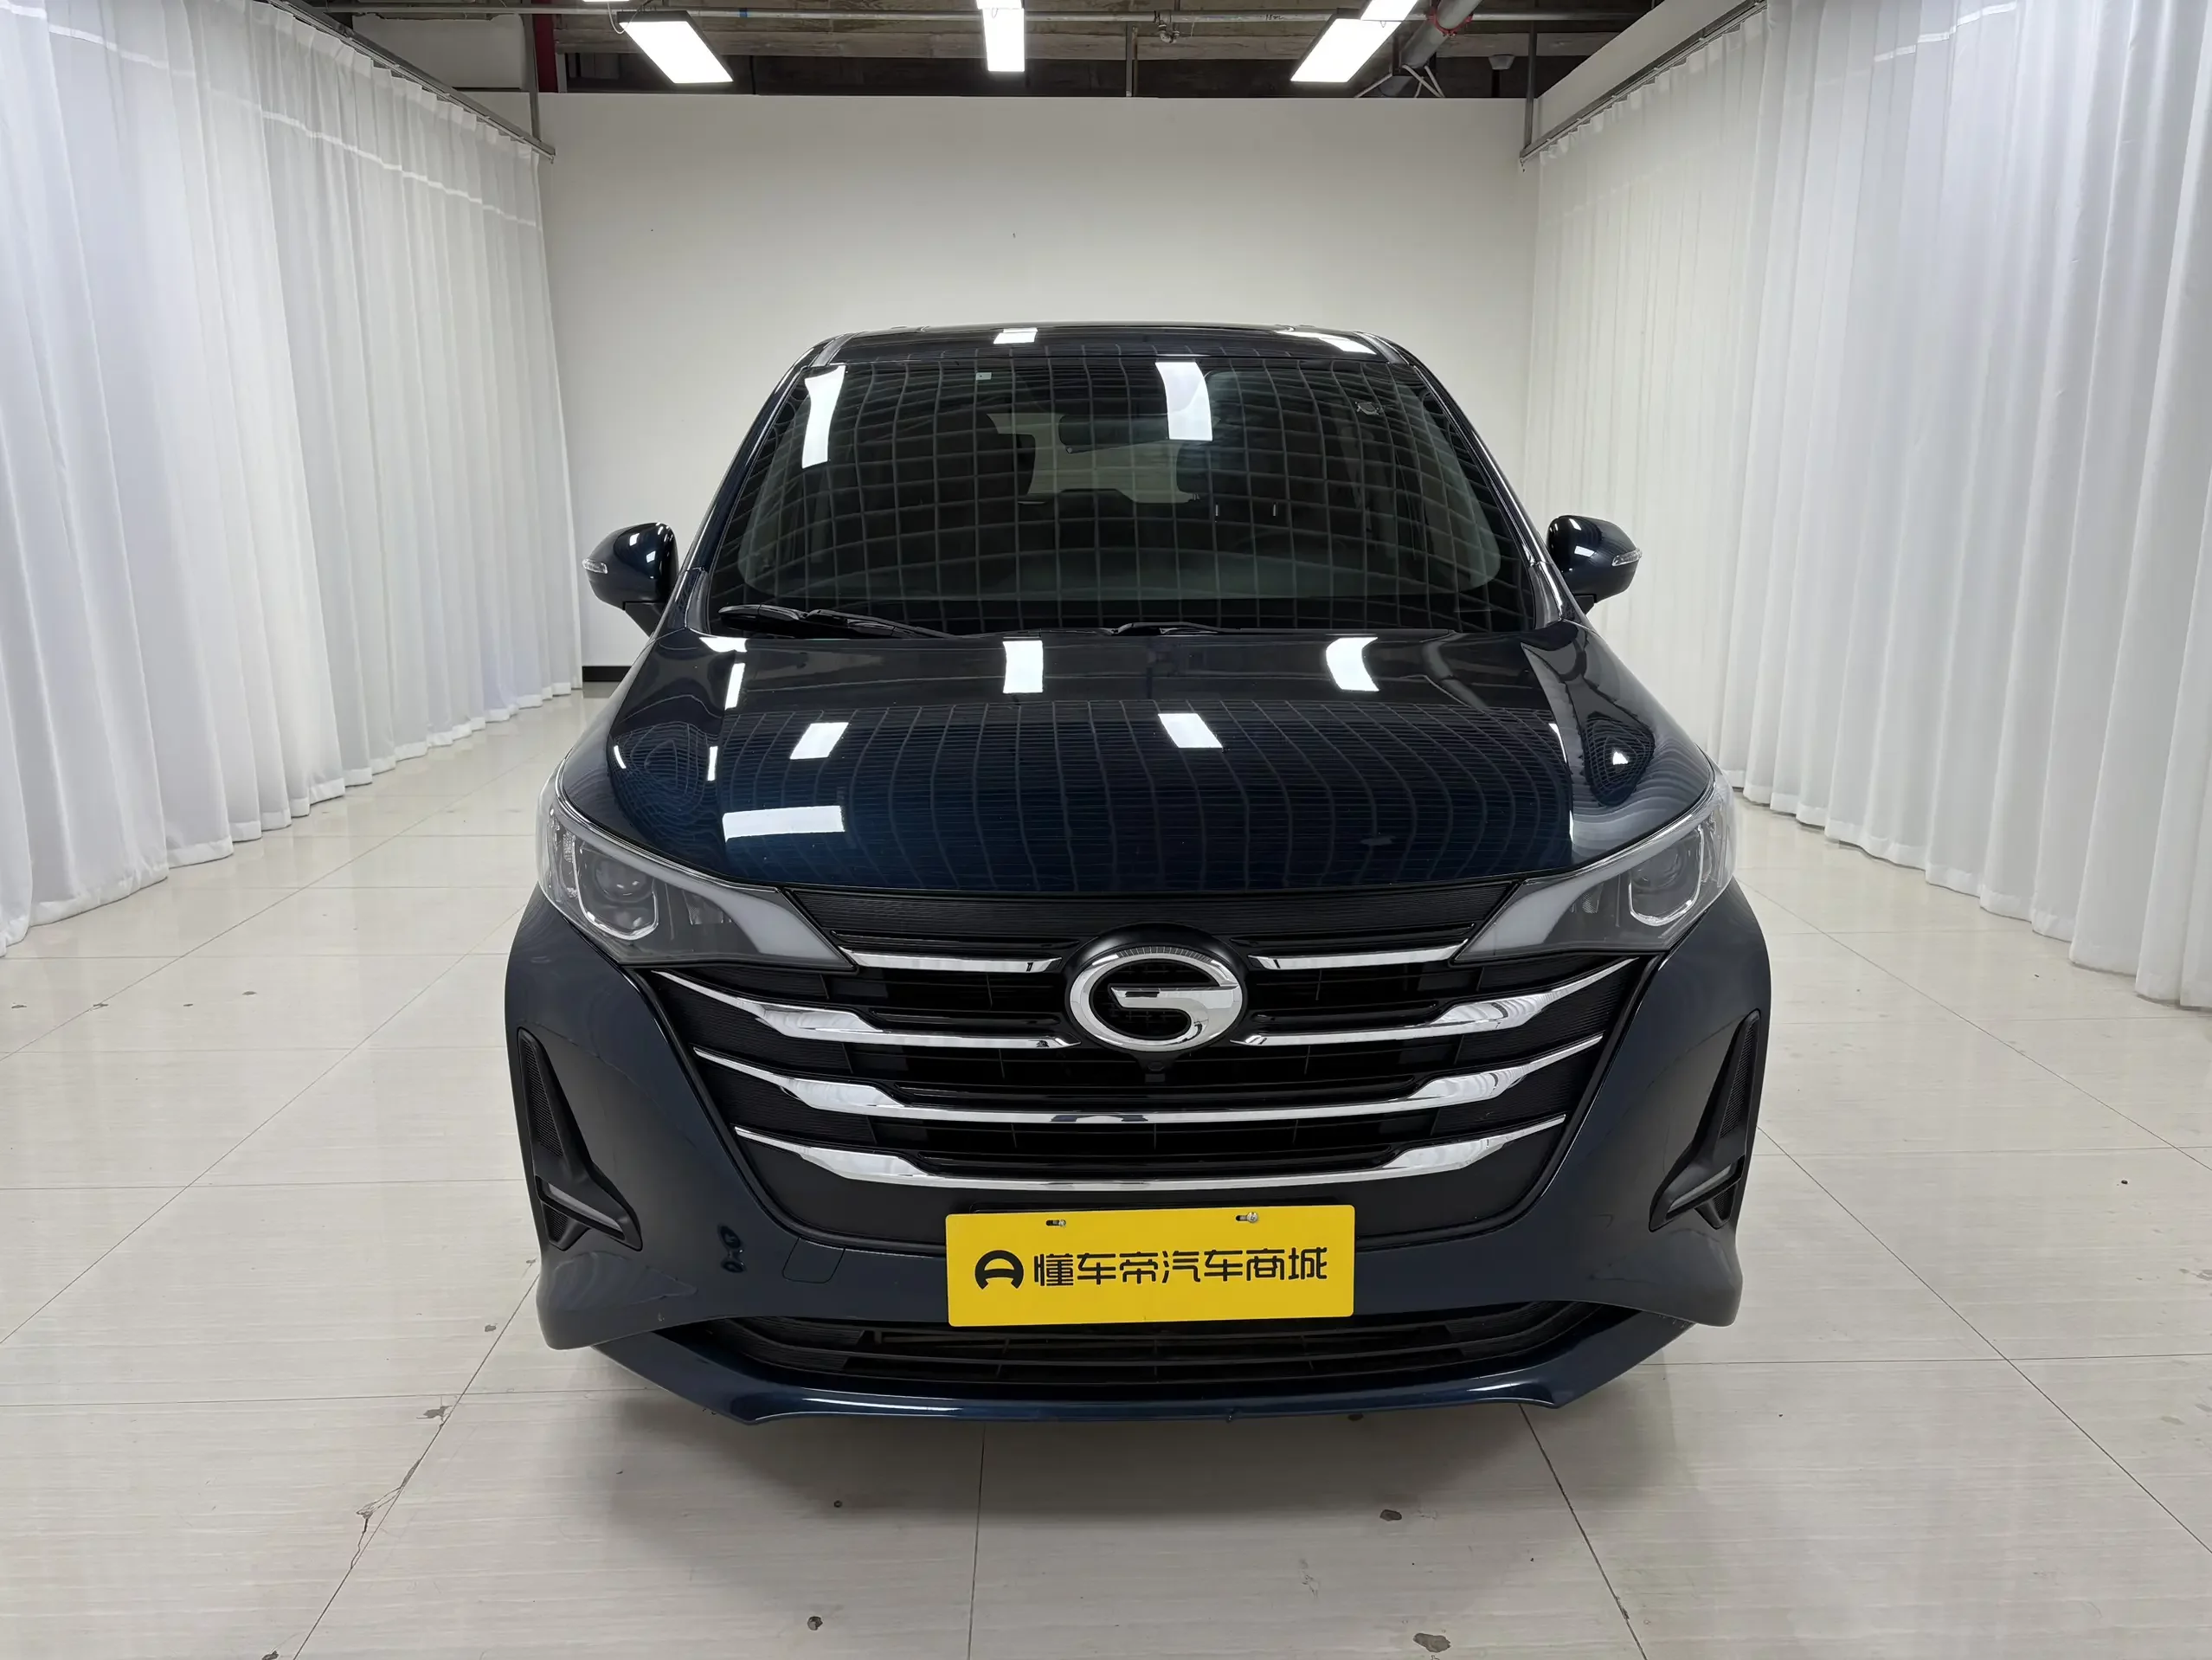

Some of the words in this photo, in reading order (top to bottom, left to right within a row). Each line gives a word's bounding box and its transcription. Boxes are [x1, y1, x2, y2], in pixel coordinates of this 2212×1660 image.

[1033, 1246, 1328, 1287] 懂车帝汽车商城
